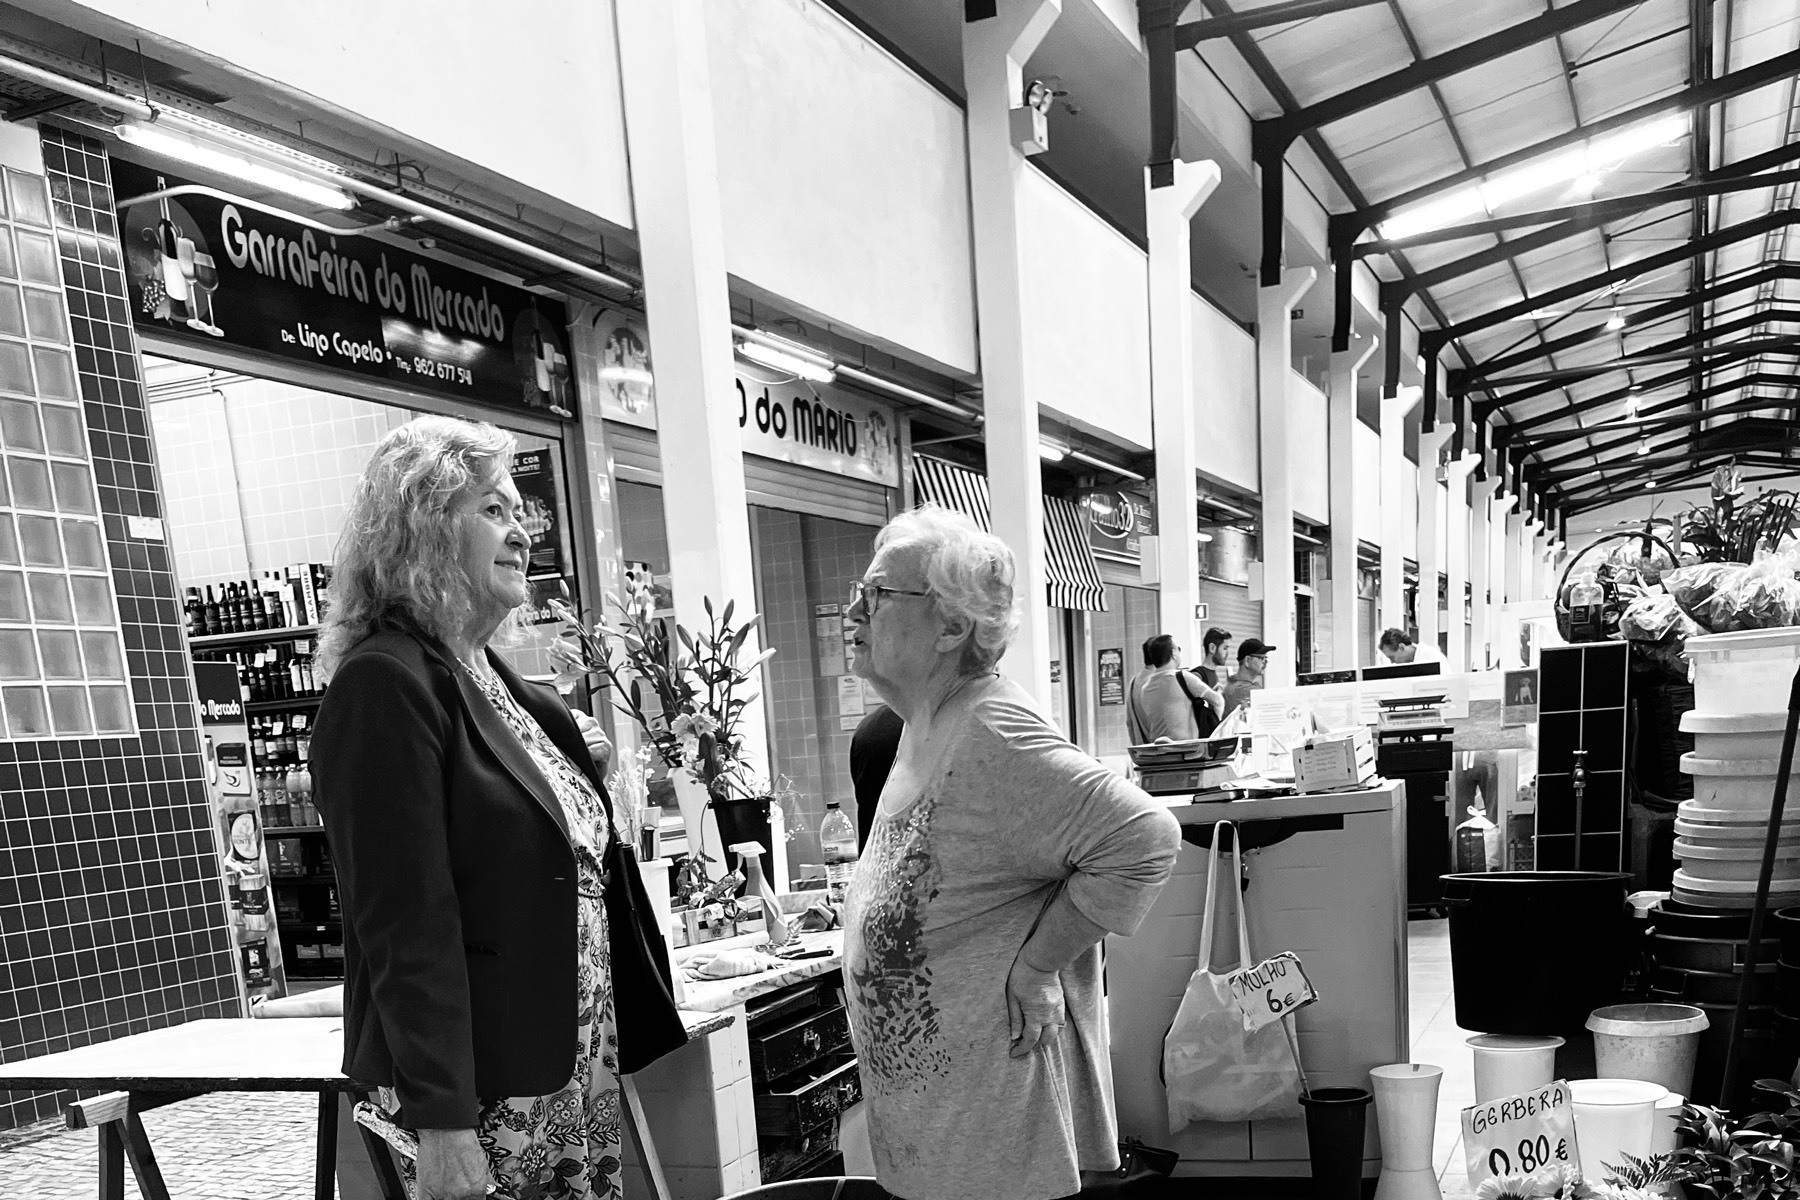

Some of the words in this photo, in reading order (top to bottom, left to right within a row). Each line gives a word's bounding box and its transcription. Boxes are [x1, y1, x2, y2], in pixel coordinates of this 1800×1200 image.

[221, 204, 369, 304] Garrafeira
[375, 252, 406, 313] do
[411, 263, 504, 341] Mercado
[298, 322, 329, 357] Lino
[332, 332, 383, 364] Capelo
[414, 356, 436, 377] 962
[436, 362, 455, 382] 677
[755, 387, 786, 438] do
[207, 699, 241, 720] Mercado
[1473, 1088, 1564, 1135] GERBERA
